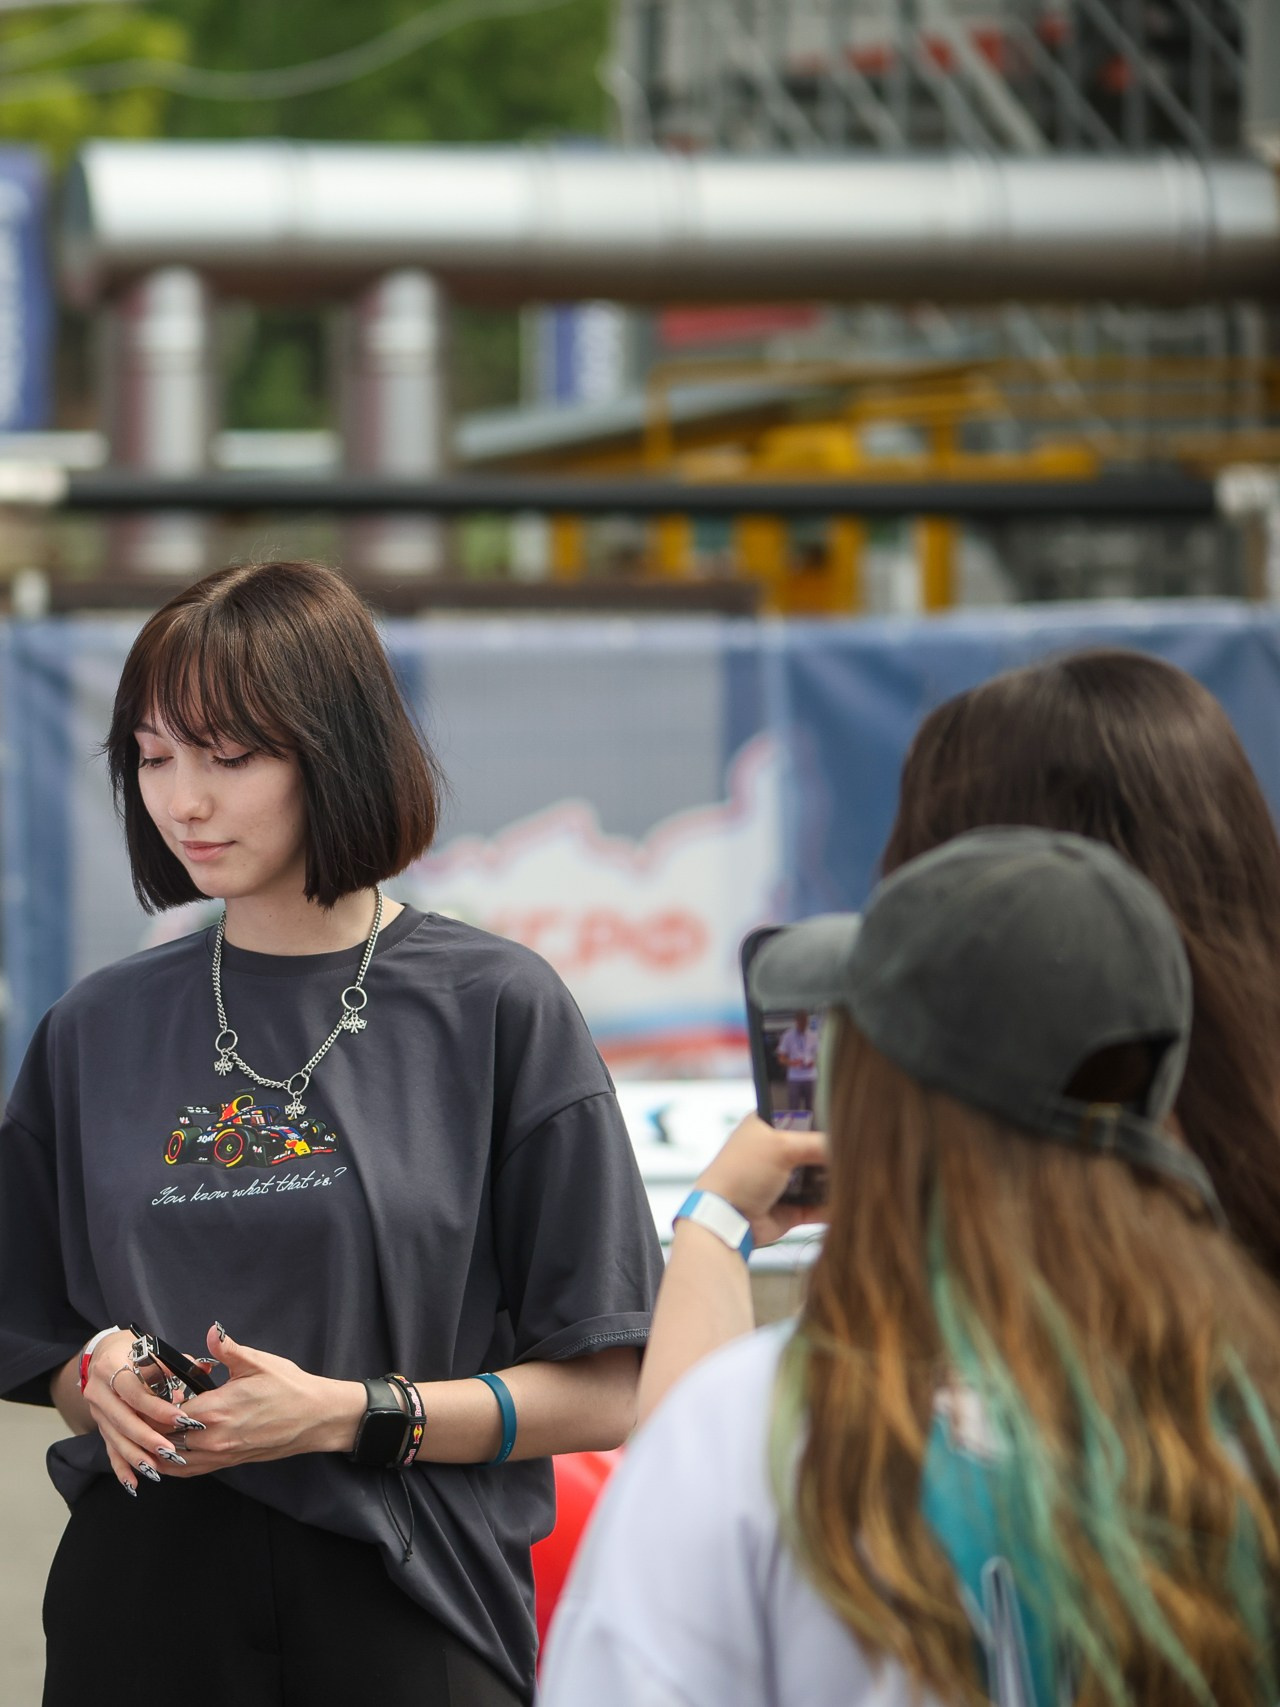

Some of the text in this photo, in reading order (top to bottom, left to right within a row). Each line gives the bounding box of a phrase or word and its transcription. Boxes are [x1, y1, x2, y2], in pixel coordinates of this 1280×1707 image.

[151, 1186, 187, 1206] You
[190, 1183, 230, 1202] know
[232, 1175, 276, 1198] what
[276, 1170, 316, 1193] that
